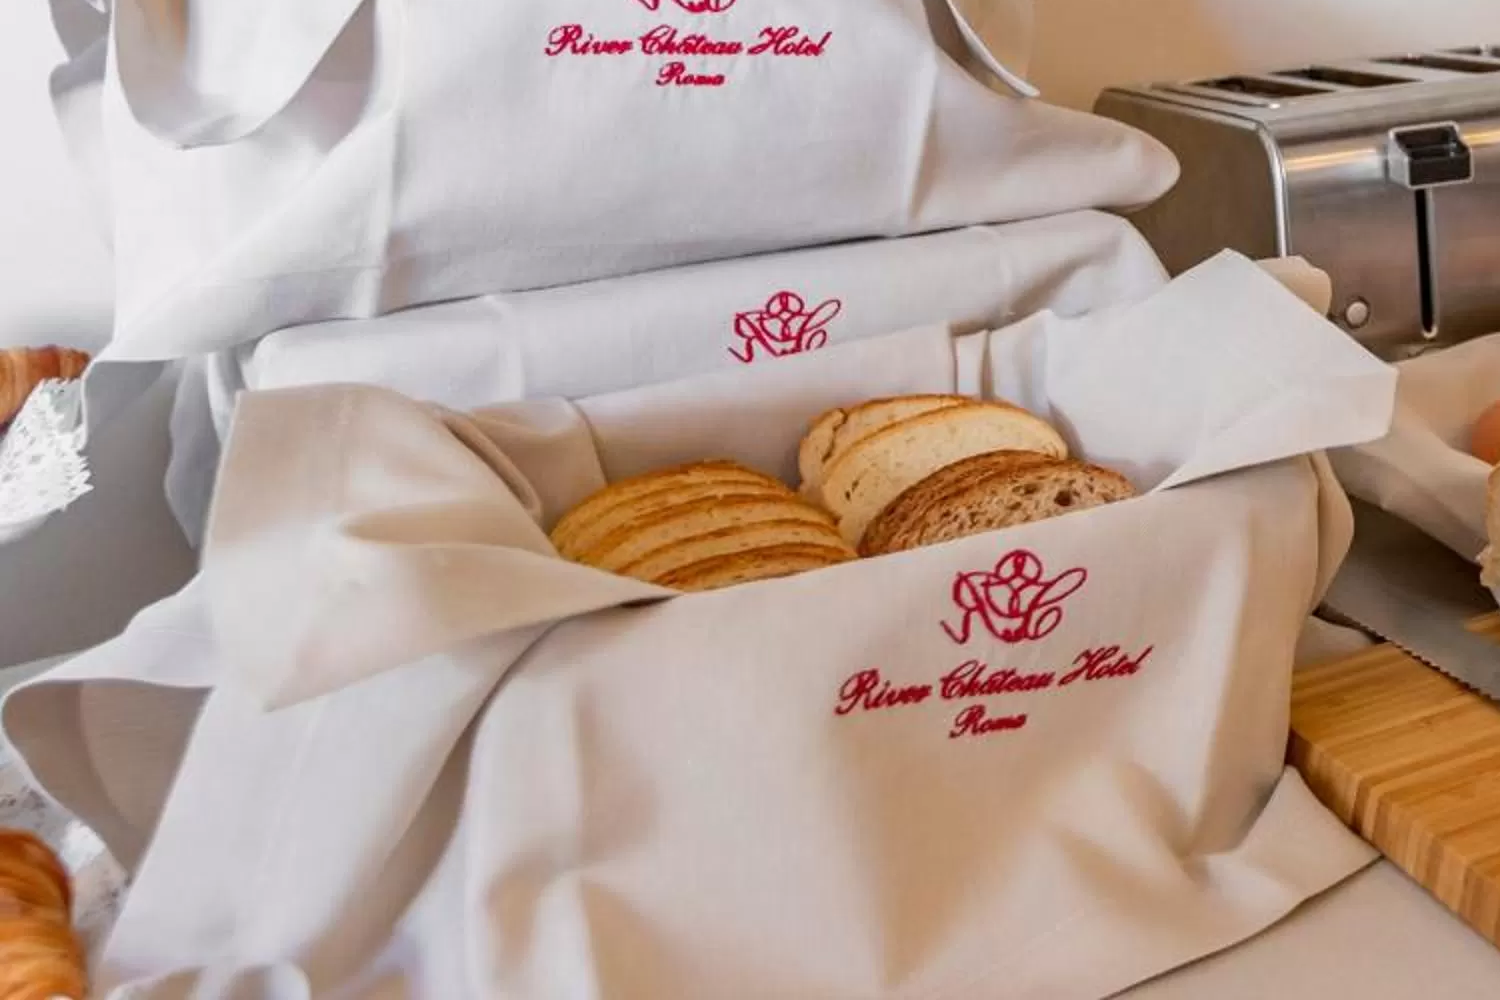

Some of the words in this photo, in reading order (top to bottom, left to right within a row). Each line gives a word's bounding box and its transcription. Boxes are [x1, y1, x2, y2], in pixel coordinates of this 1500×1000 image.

[545, 23, 633, 56] River
[747, 25, 833, 57] Hotel
[655, 61, 726, 87] Roma
[833, 667, 932, 716] River
[940, 659, 1056, 701] Château
[1056, 644, 1154, 686] Hotel
[948, 703, 1028, 740] Roma
